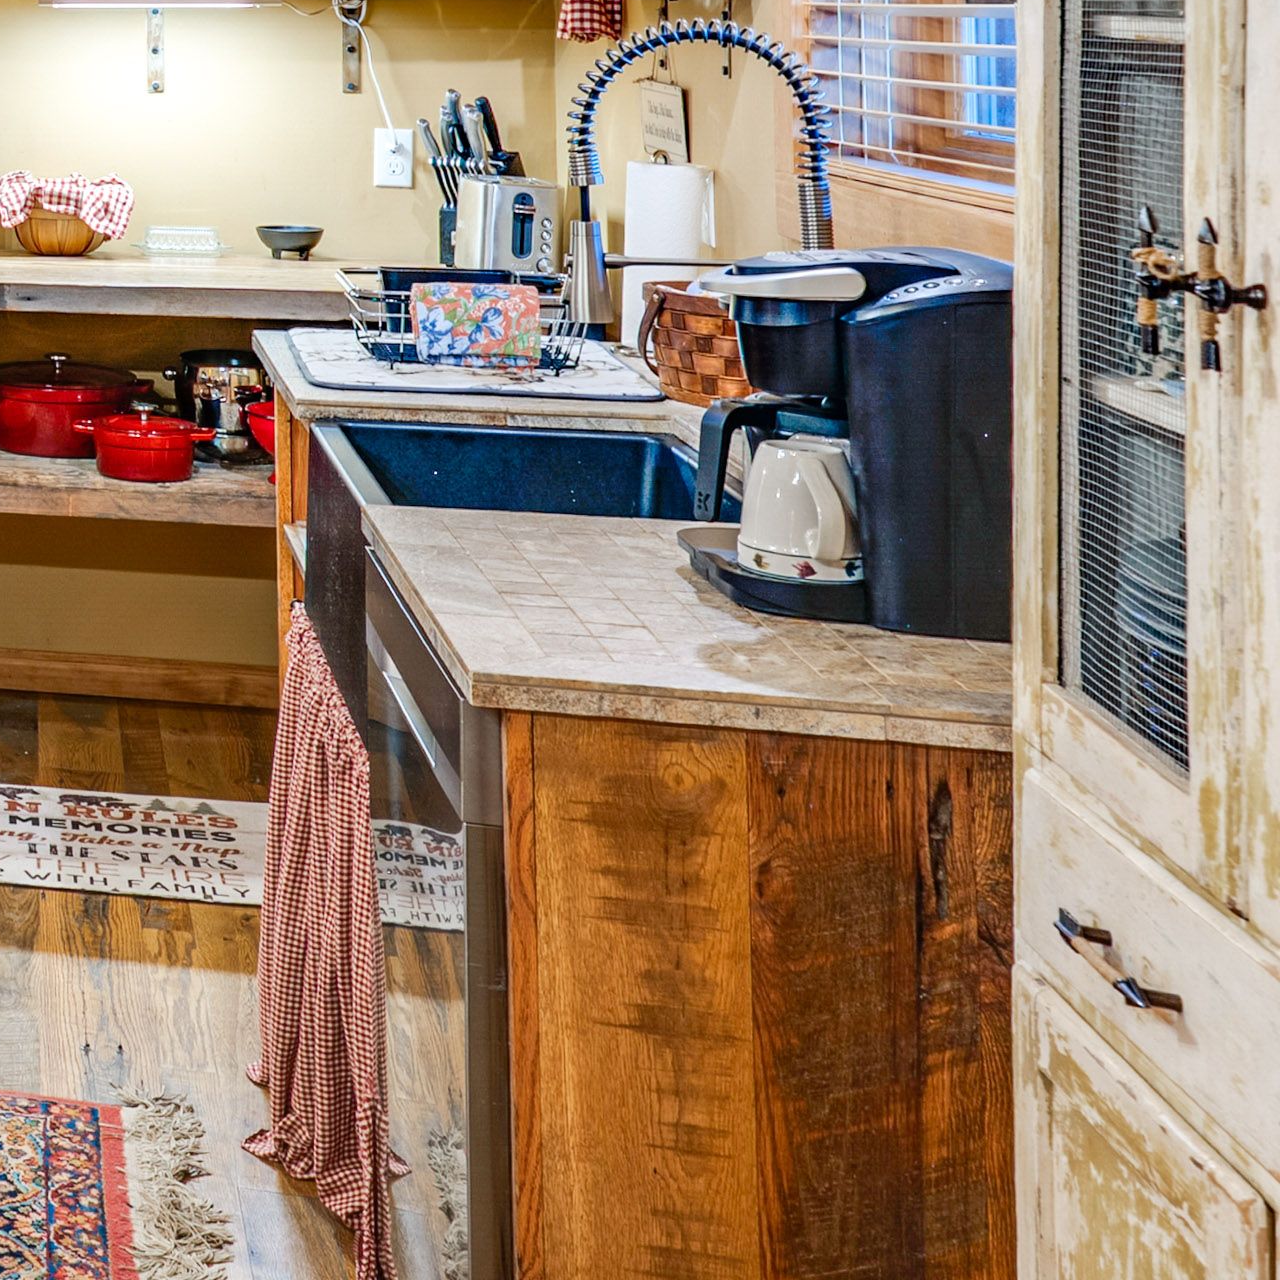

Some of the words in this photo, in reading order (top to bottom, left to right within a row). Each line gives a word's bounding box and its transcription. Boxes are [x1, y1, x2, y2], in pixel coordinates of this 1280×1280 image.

[8, 814, 237, 842] MEMORIES
[62, 804, 239, 830] RULES
[17, 841, 98, 860] THE
[110, 849, 239, 871] STARS
[60, 832, 135, 848] Take
[140, 841, 165, 850] a
[171, 841, 246, 859] Nap
[23, 869, 109, 887] WITH
[127, 878, 251, 899] FAMILY
[25, 855, 121, 877] THE
[139, 865, 249, 888] FIRE
